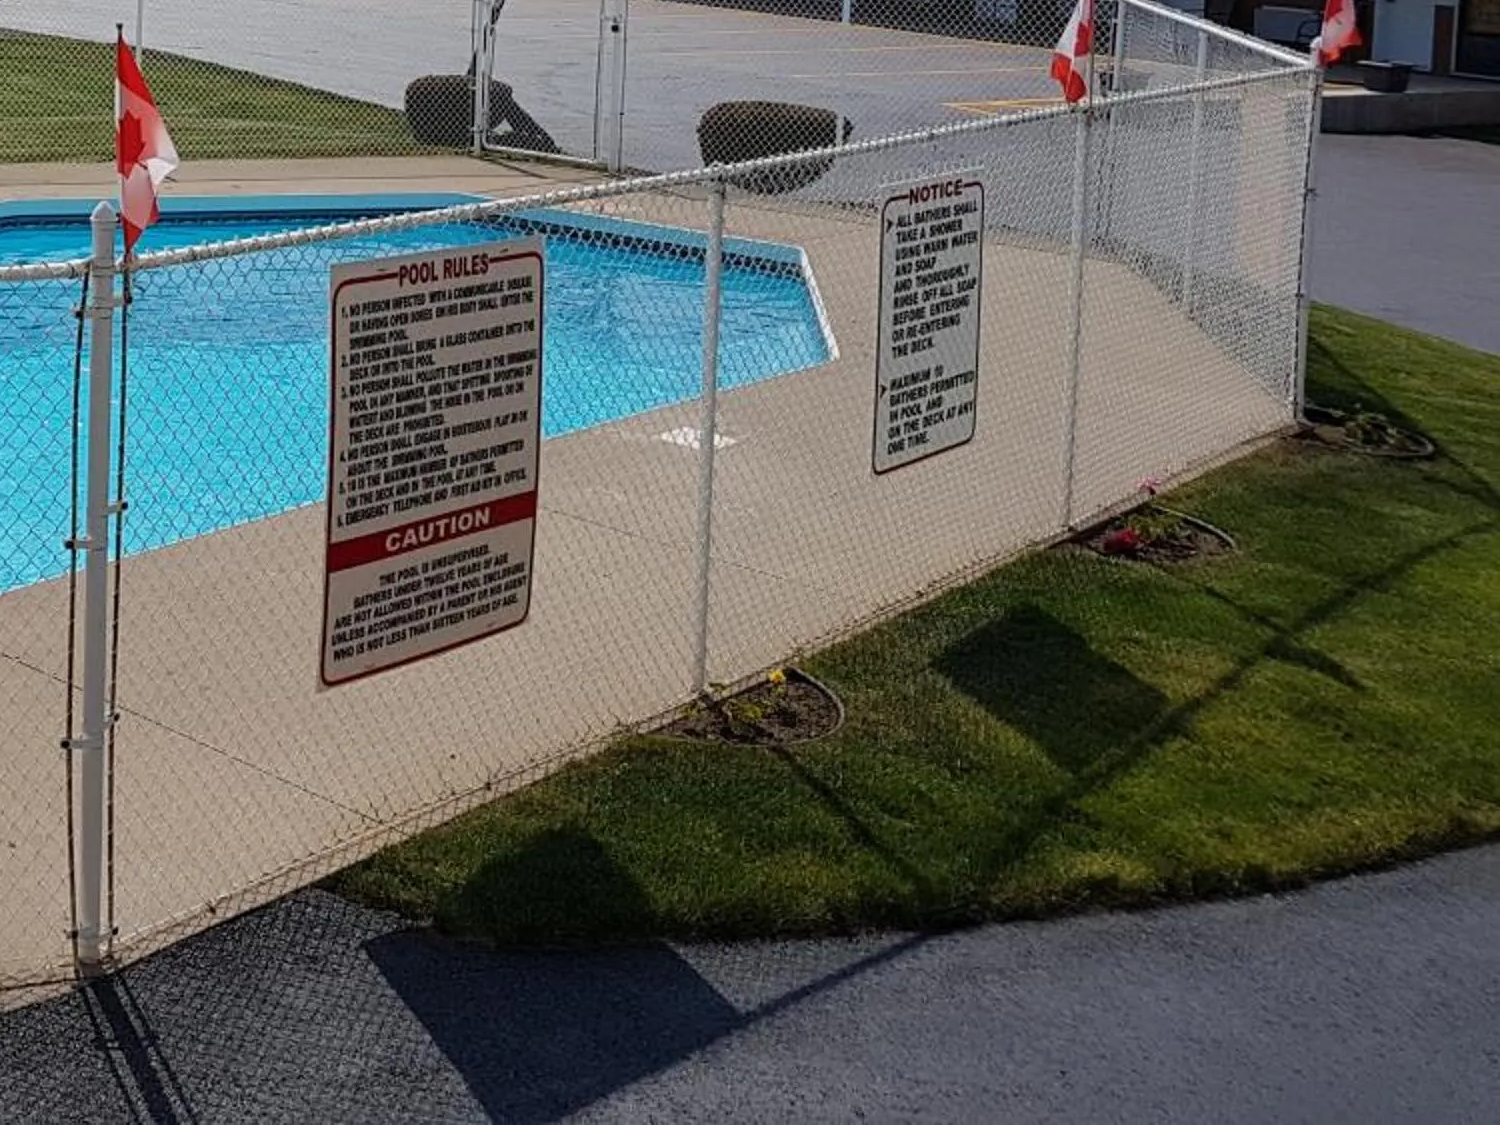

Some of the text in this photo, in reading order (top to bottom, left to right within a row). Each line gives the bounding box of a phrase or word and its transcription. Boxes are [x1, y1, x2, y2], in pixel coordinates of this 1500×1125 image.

[909, 179, 963, 205] NOTICE
[399, 253, 489, 286] POOL RULES
[385, 506, 490, 552] CAUTION
